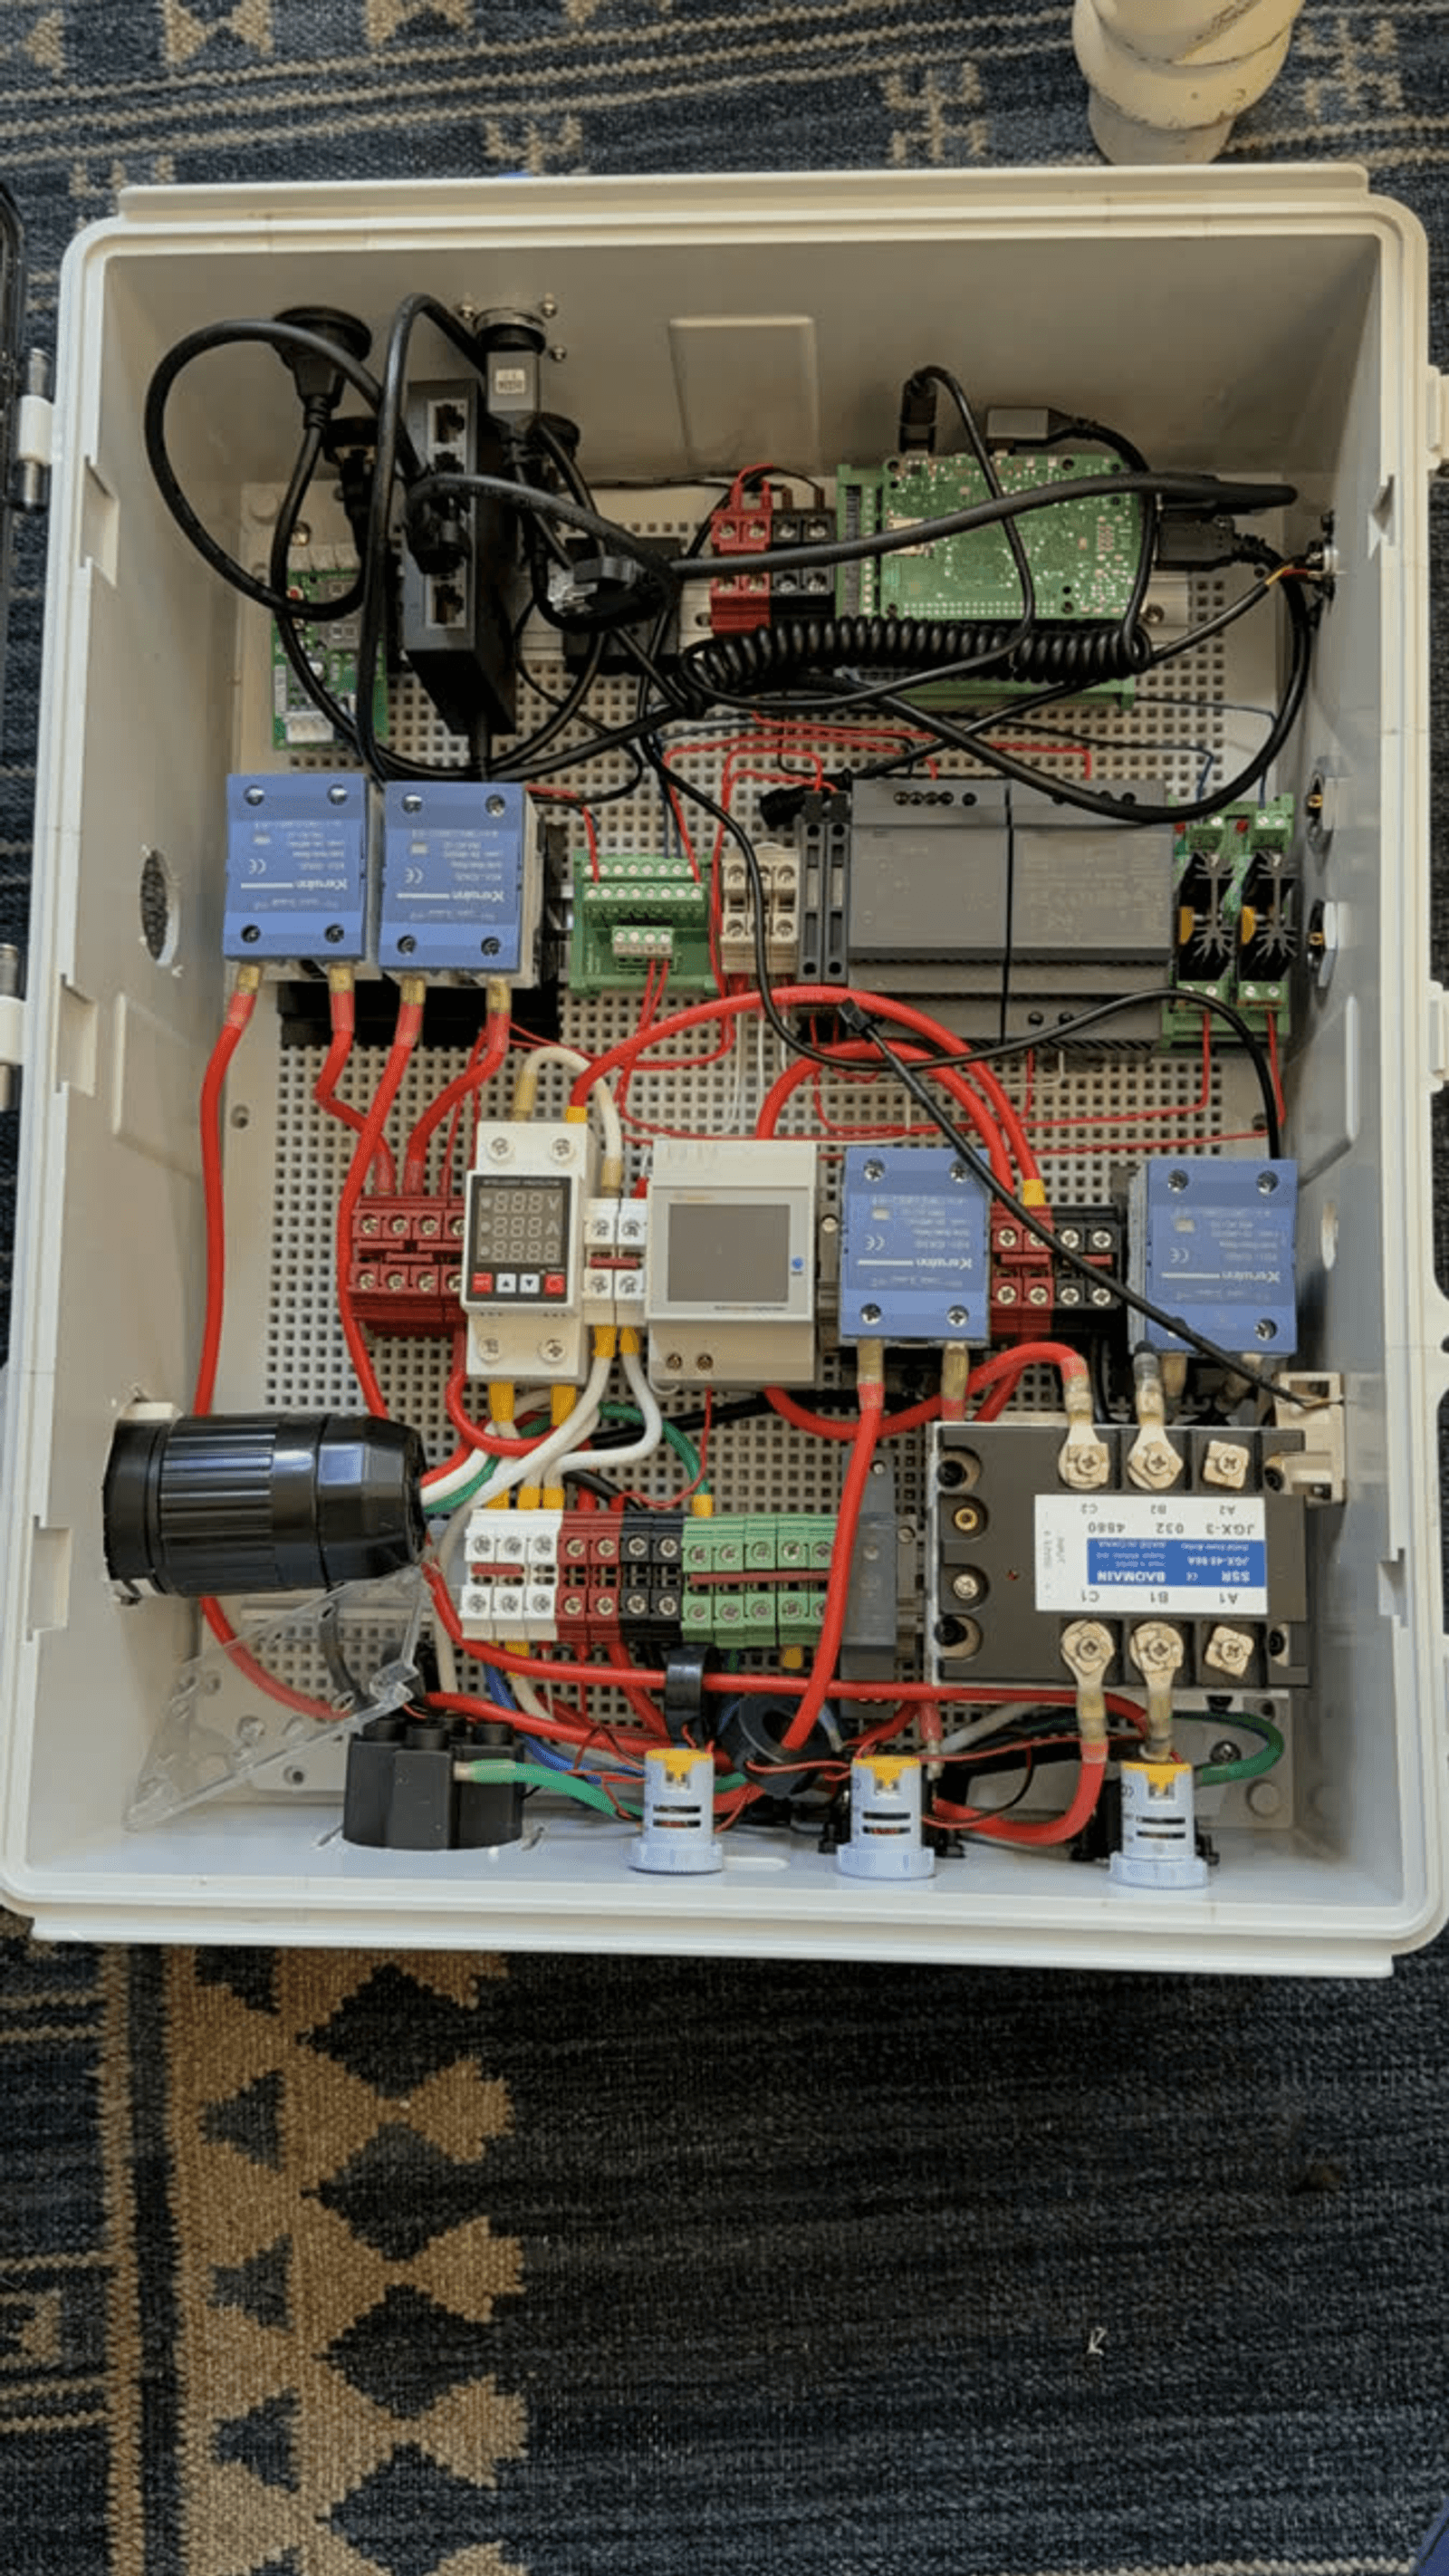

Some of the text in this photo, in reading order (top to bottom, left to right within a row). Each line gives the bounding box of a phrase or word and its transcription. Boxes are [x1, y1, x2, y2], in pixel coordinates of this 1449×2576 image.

[1081, 1504, 1098, 1514] C2
[1150, 1504, 1166, 1514] B2
[1219, 1504, 1235, 1514] A2
[1156, 1523, 1185, 1534] 032
[1206, 1523, 1255, 1535] JGX-3
[1097, 1571, 1166, 1582] BAOMAIN
[1221, 1571, 1250, 1582] SSR
[1081, 1591, 1099, 1603] C1
[1150, 1592, 1168, 1604] B1
[1219, 1592, 1238, 1604] A1
